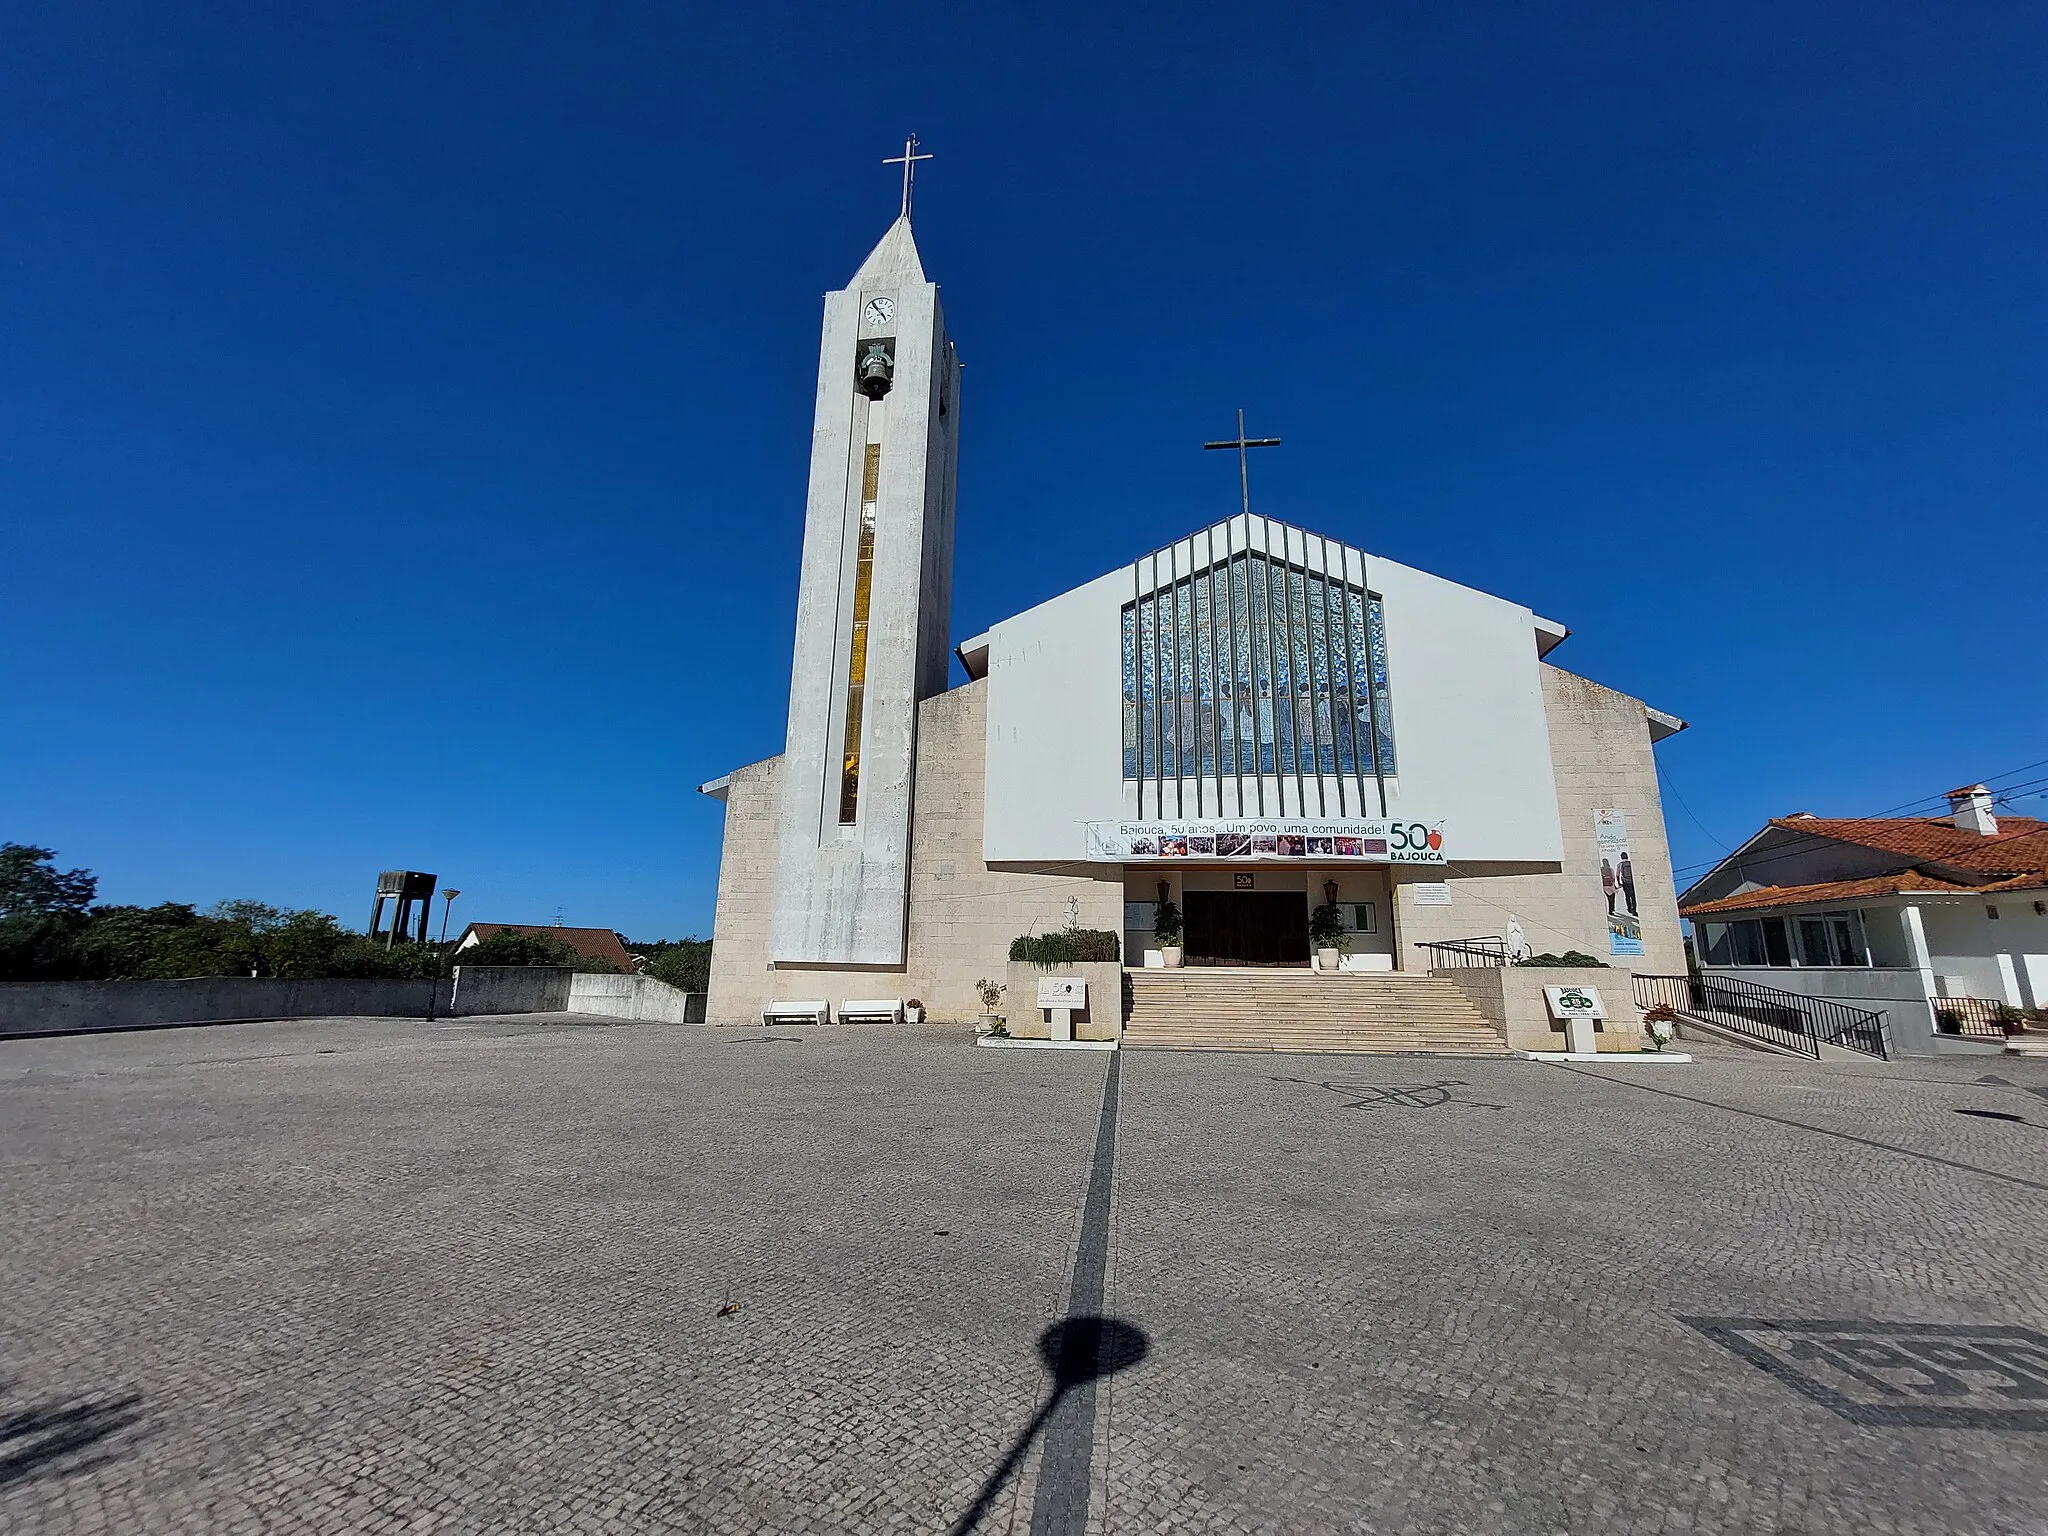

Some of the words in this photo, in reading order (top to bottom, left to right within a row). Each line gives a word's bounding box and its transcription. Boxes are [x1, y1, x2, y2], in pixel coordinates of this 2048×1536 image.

[1120, 825, 1166, 836] Bajouca,
[1171, 824, 1185, 834] 50
[1250, 823, 1280, 834] povo,
[1284, 825, 1308, 834] uma
[1312, 824, 1386, 835] comunidade!
[1390, 823, 1429, 851] 50
[1390, 852, 1443, 861] BAJOUCA
